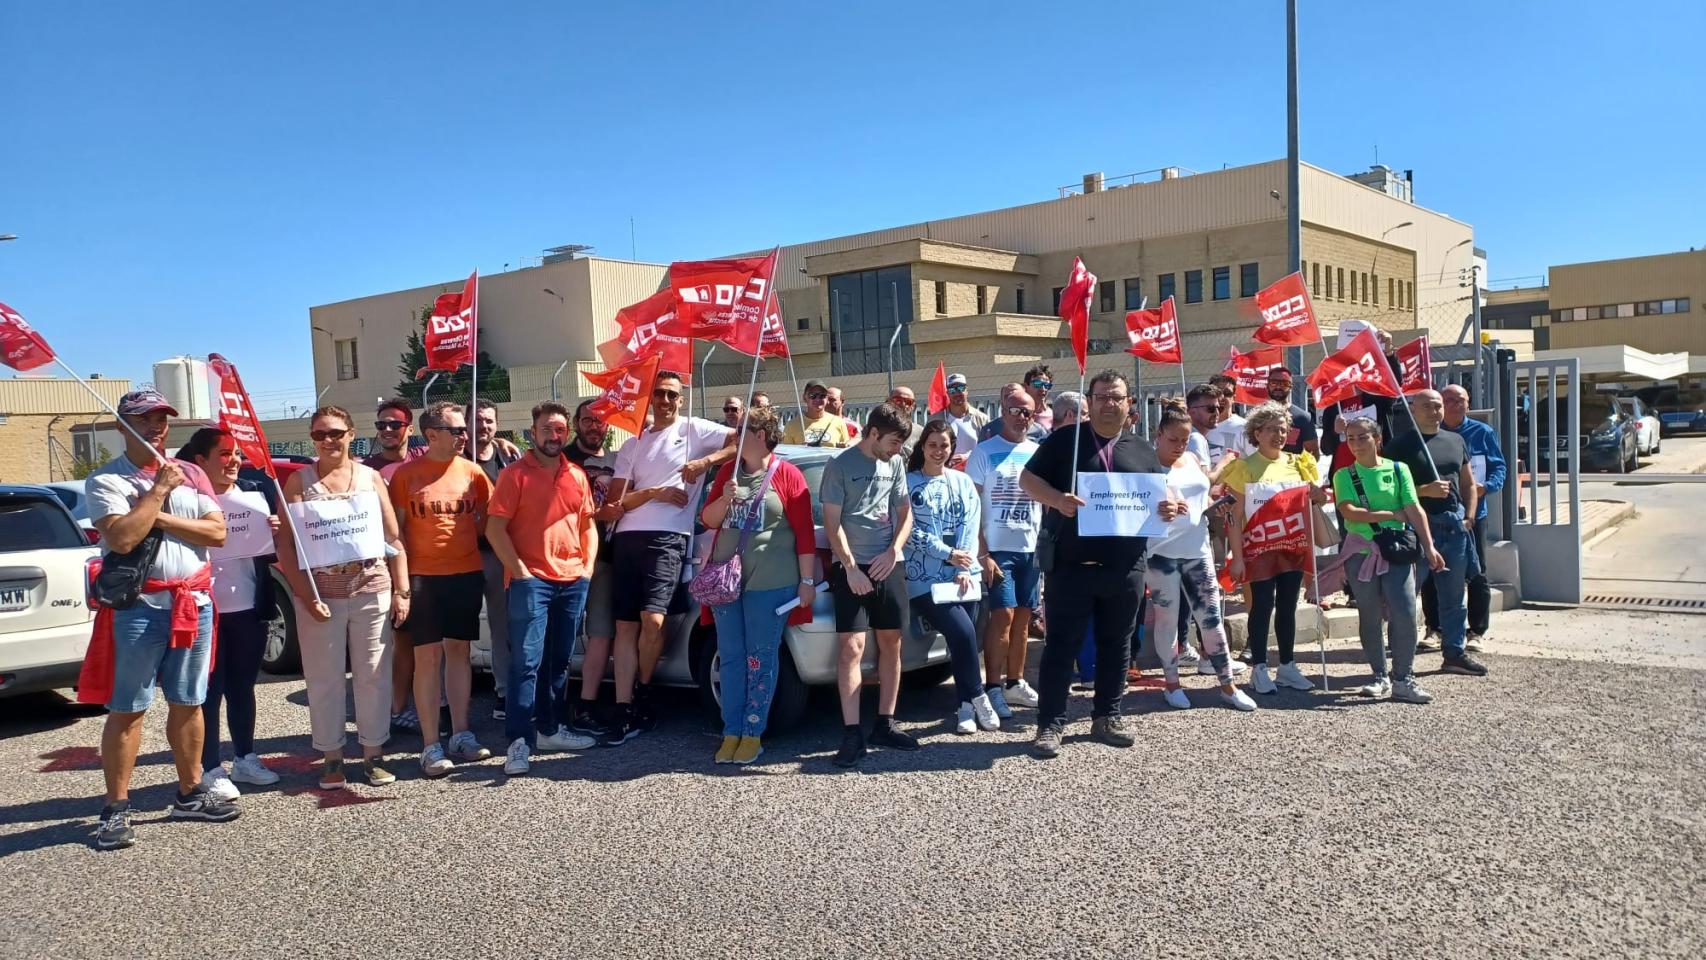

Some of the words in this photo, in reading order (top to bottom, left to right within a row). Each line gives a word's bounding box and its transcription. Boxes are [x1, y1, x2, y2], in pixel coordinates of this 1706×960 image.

[1091, 491, 1130, 500] Employees
[1131, 491, 1151, 500] first?
[1133, 504, 1148, 512] too!
[228, 510, 251, 522] first?
[305, 516, 346, 529] Employees
[347, 511, 368, 523] first?
[231, 524, 249, 533] too!
[310, 533, 329, 541] Then
[330, 529, 350, 538] here
[351, 525, 368, 534] too!
[51, 599, 72, 607] ONE
